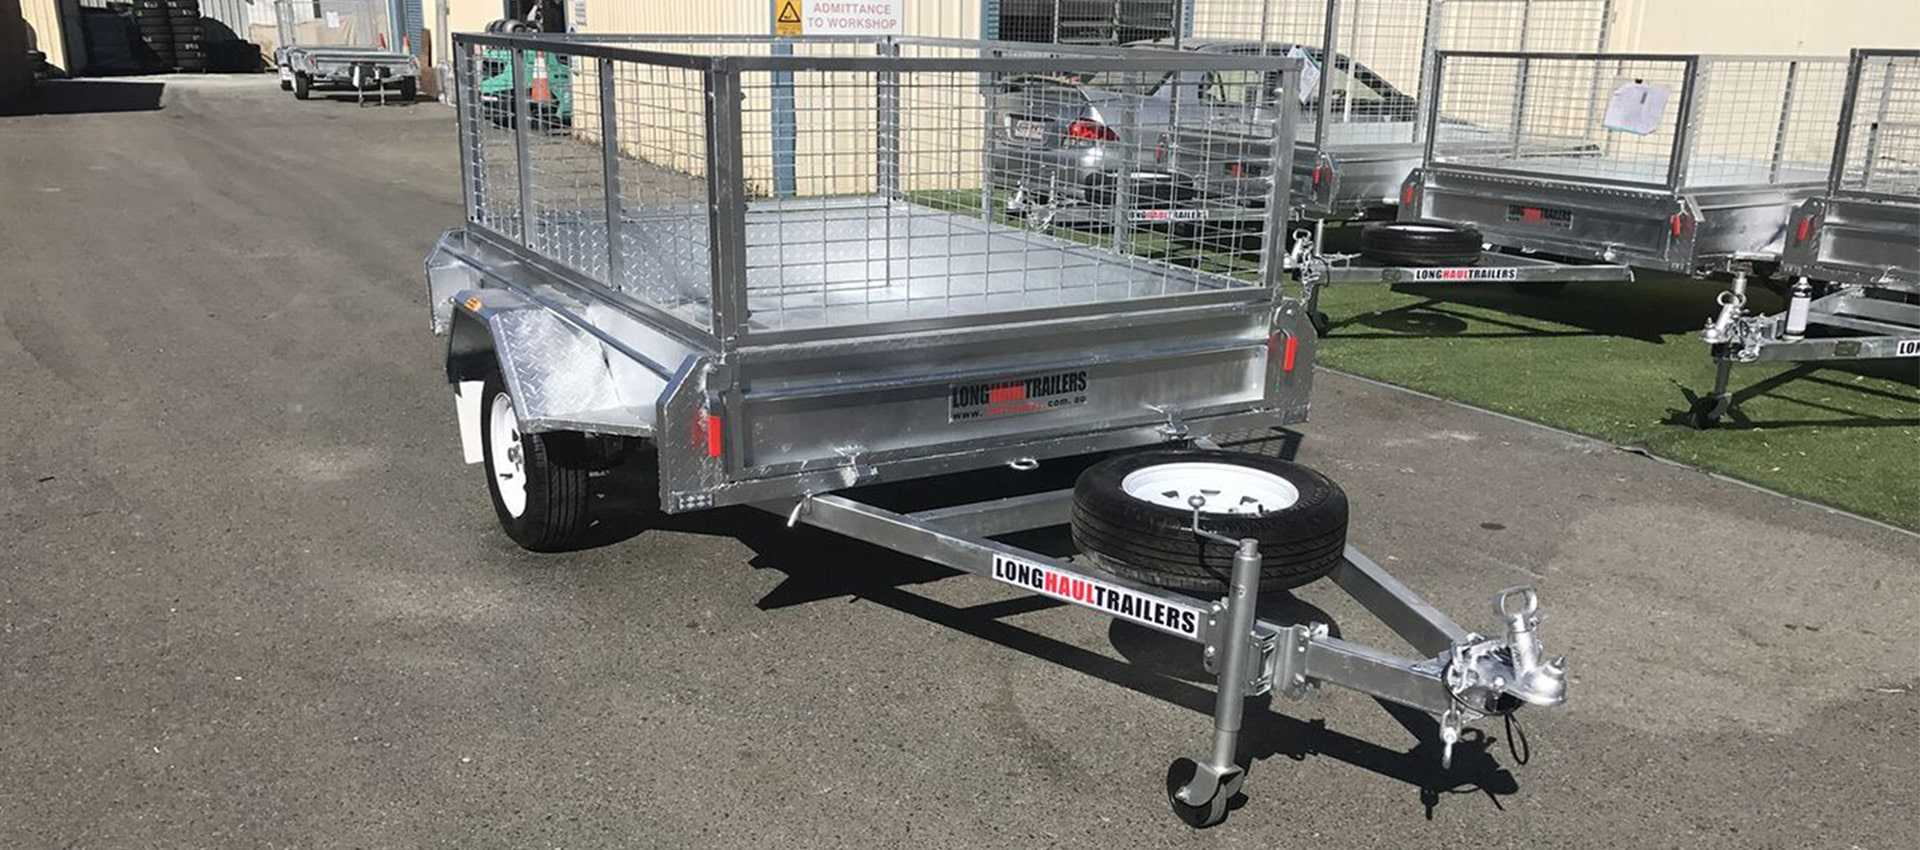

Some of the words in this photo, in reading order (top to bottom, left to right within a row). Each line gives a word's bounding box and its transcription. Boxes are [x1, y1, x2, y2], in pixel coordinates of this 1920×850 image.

[813, 2, 892, 15] ADMITTANCE
[807, 17, 824, 28] TO
[828, 18, 897, 29] WORKSHOP
[1416, 268, 1516, 280] LONGHAULTRAILERS
[995, 557, 1196, 634] LONGHAULTRAILERS
